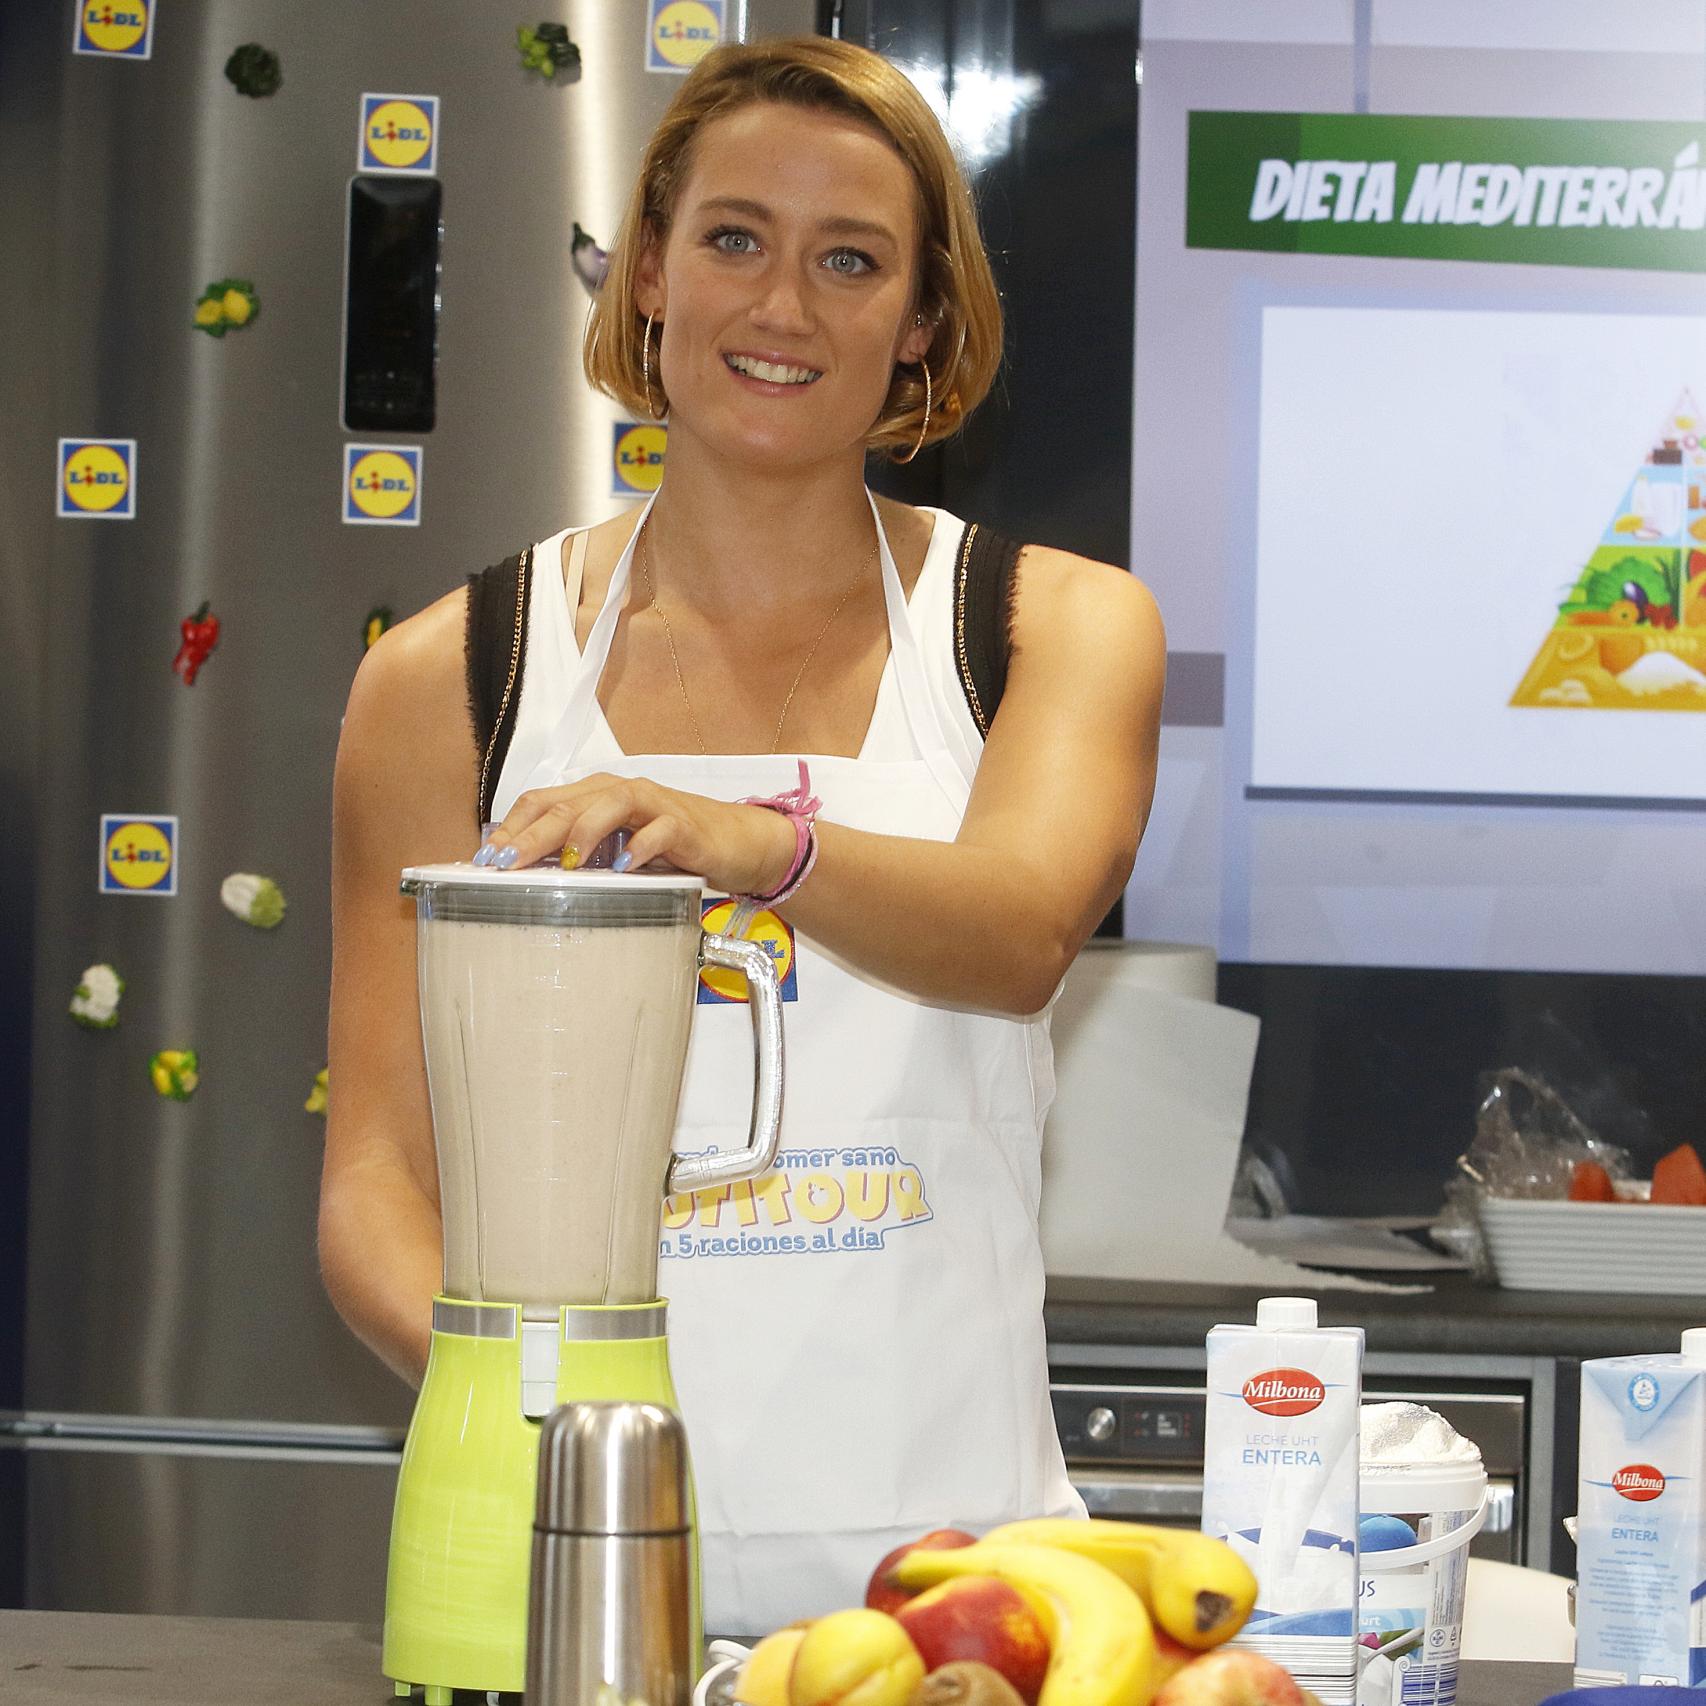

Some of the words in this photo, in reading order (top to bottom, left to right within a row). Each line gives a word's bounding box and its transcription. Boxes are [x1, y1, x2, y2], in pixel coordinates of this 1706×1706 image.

[1249, 158, 1397, 222] DIETA
[1402, 141, 1706, 230] MEDITERRÁ
[772, 1149, 835, 1169] omer
[841, 1147, 897, 1167] sano
[678, 1233, 693, 1254] 5
[699, 1231, 806, 1253] raciones
[812, 1227, 836, 1250] al
[841, 1225, 882, 1248] día
[1244, 1379, 1322, 1400] Milbona
[1246, 1433, 1289, 1446] LECHE
[1292, 1435, 1320, 1447] UHT
[1242, 1448, 1323, 1466] ENTERA
[1612, 1471, 1665, 1489] Milbona
[1611, 1527, 1660, 1542] ENTERA
